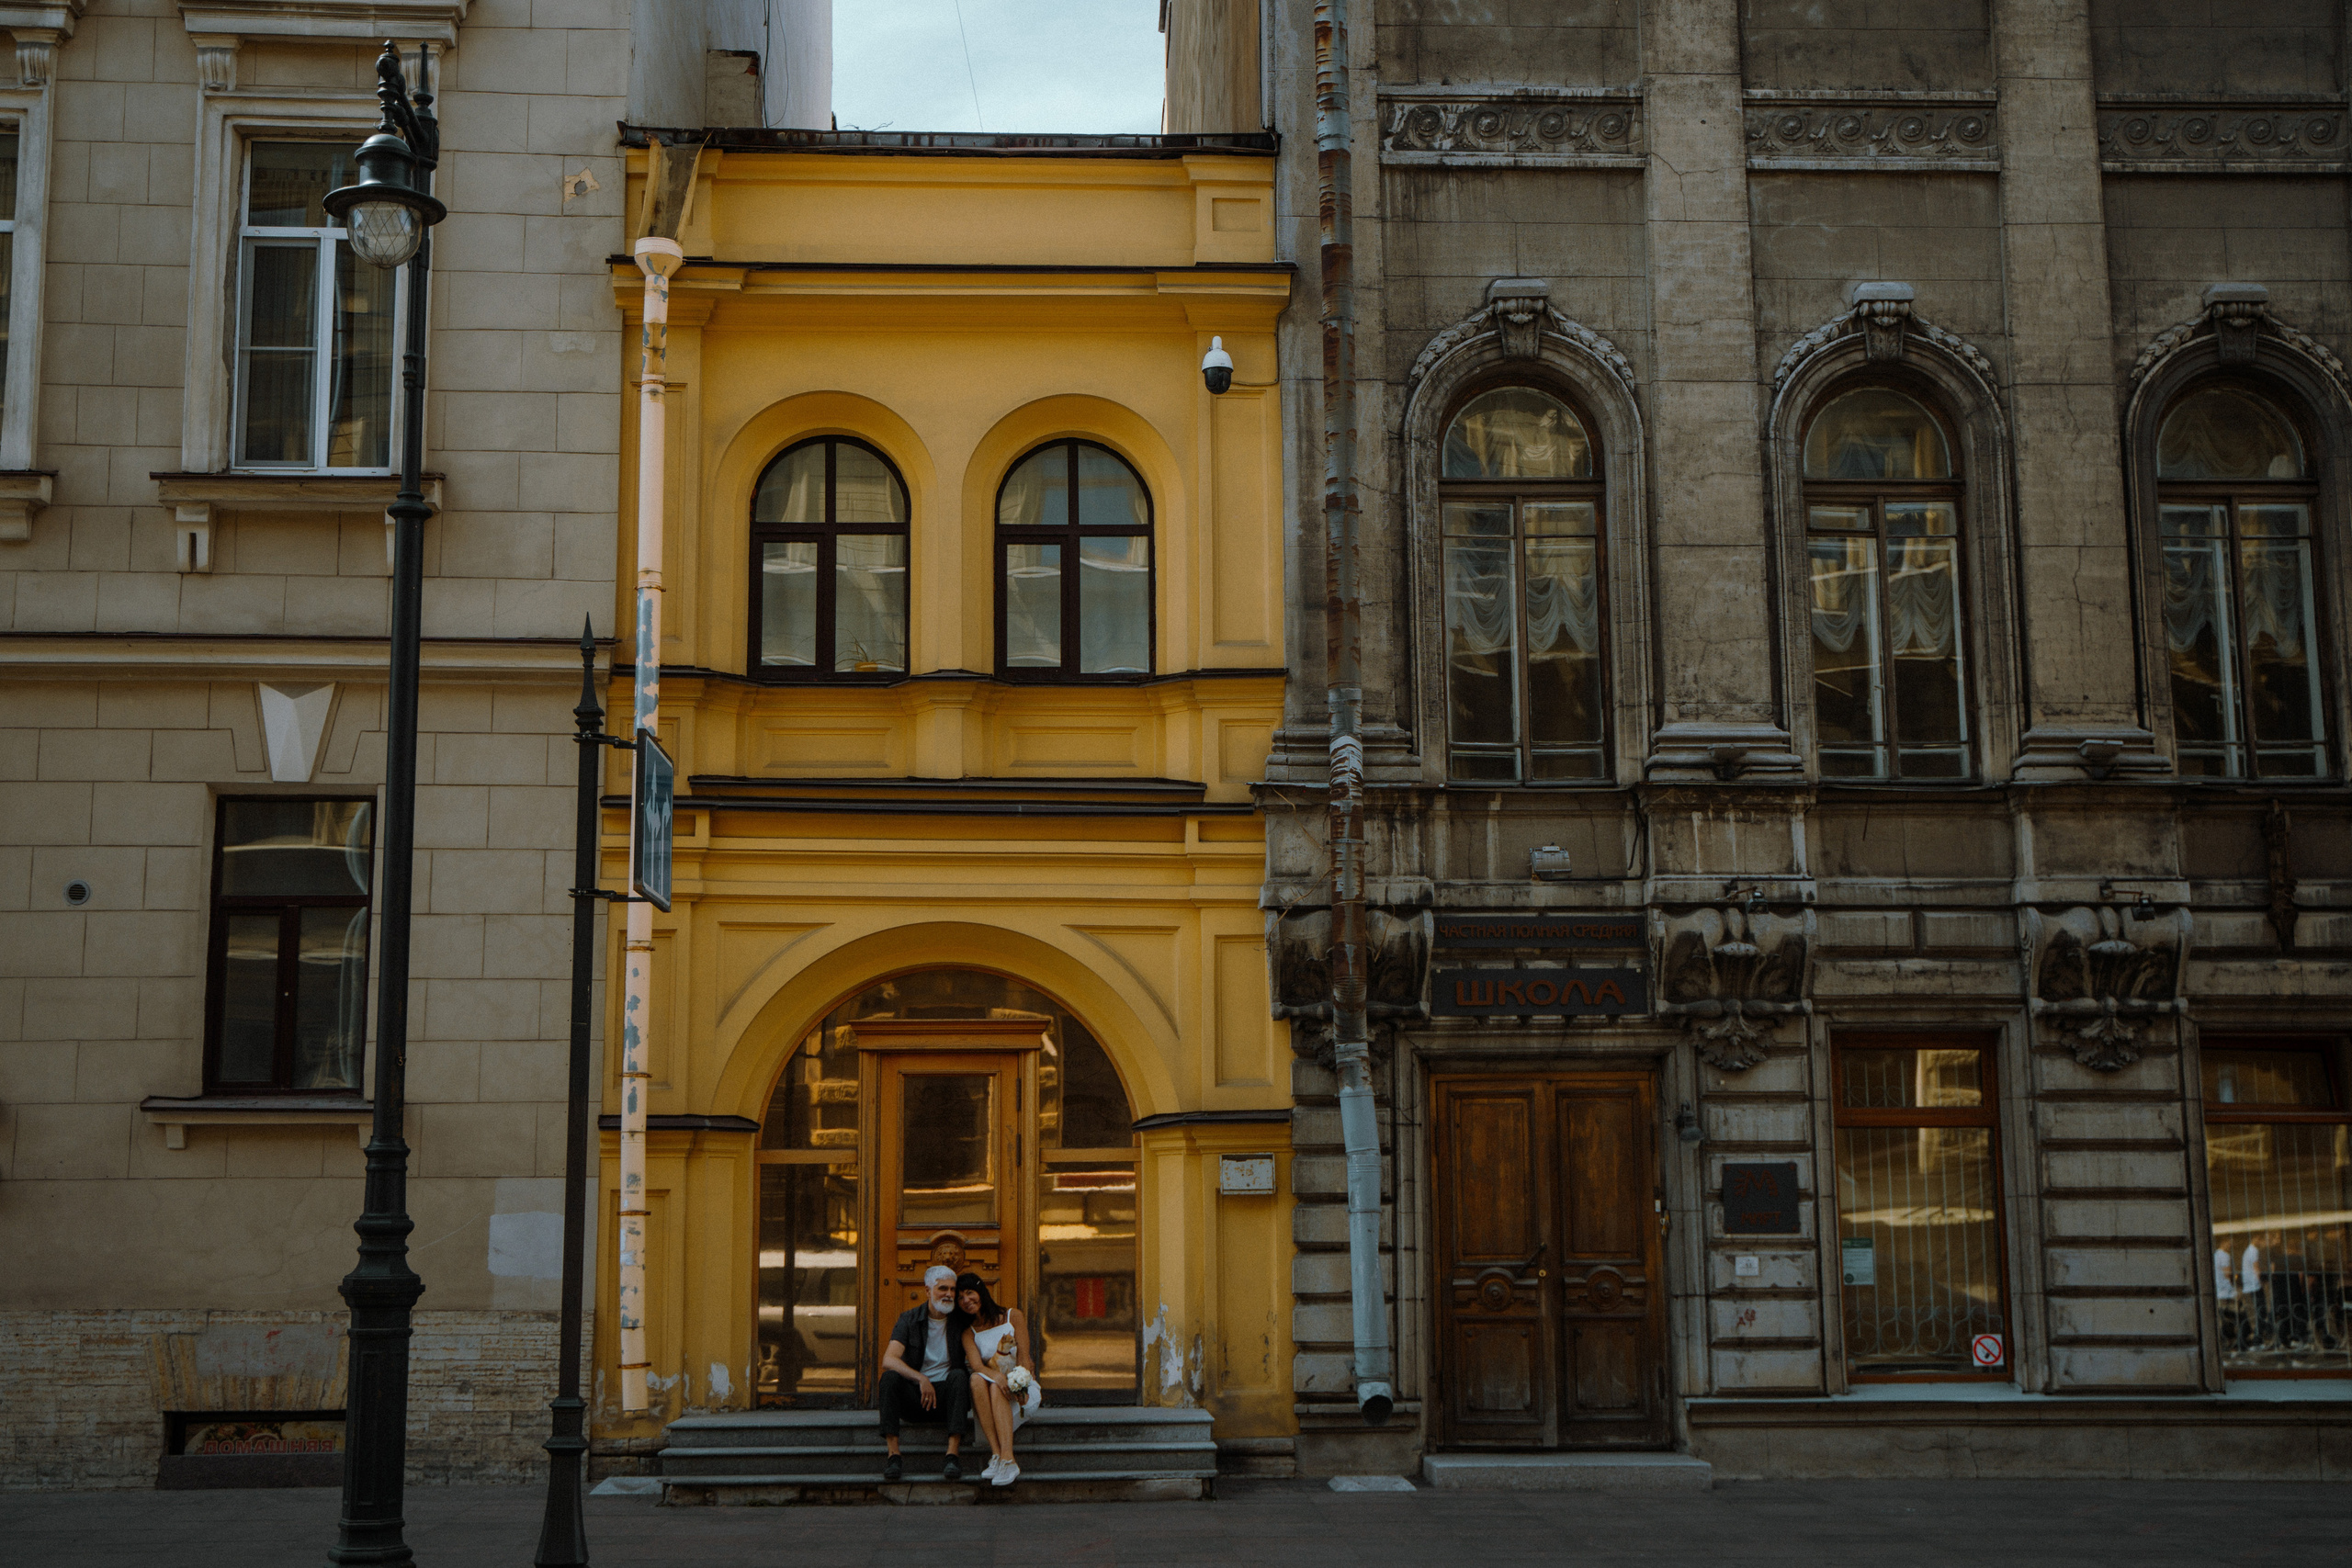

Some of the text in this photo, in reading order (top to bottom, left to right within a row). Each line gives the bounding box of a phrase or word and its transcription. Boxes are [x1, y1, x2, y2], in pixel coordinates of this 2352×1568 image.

[1439, 924, 1638, 939] ЧАСТНАЯ ПОЛНАЯ СРЕДНЯЯ
[1455, 978, 1627, 1007] ШКОЛА
[202, 1438, 334, 1455] ДОМАШНЯЯ
